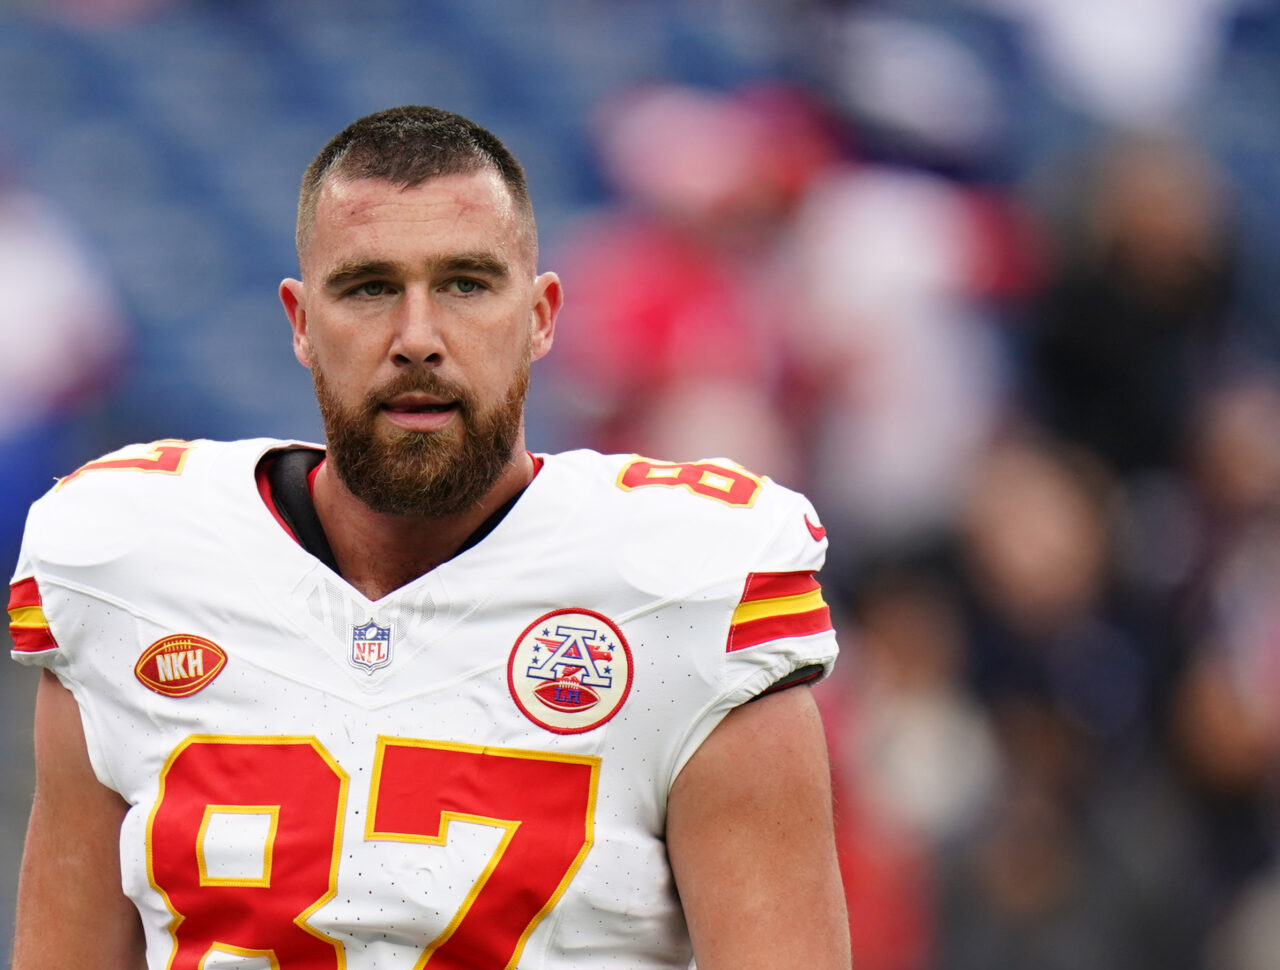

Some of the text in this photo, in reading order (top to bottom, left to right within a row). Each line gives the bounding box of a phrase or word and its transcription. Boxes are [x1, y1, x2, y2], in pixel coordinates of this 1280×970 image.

[616, 453, 768, 508] 8
[156, 649, 204, 682] NKH
[355, 642, 386, 663] NFL
[554, 687, 581, 704] LH
